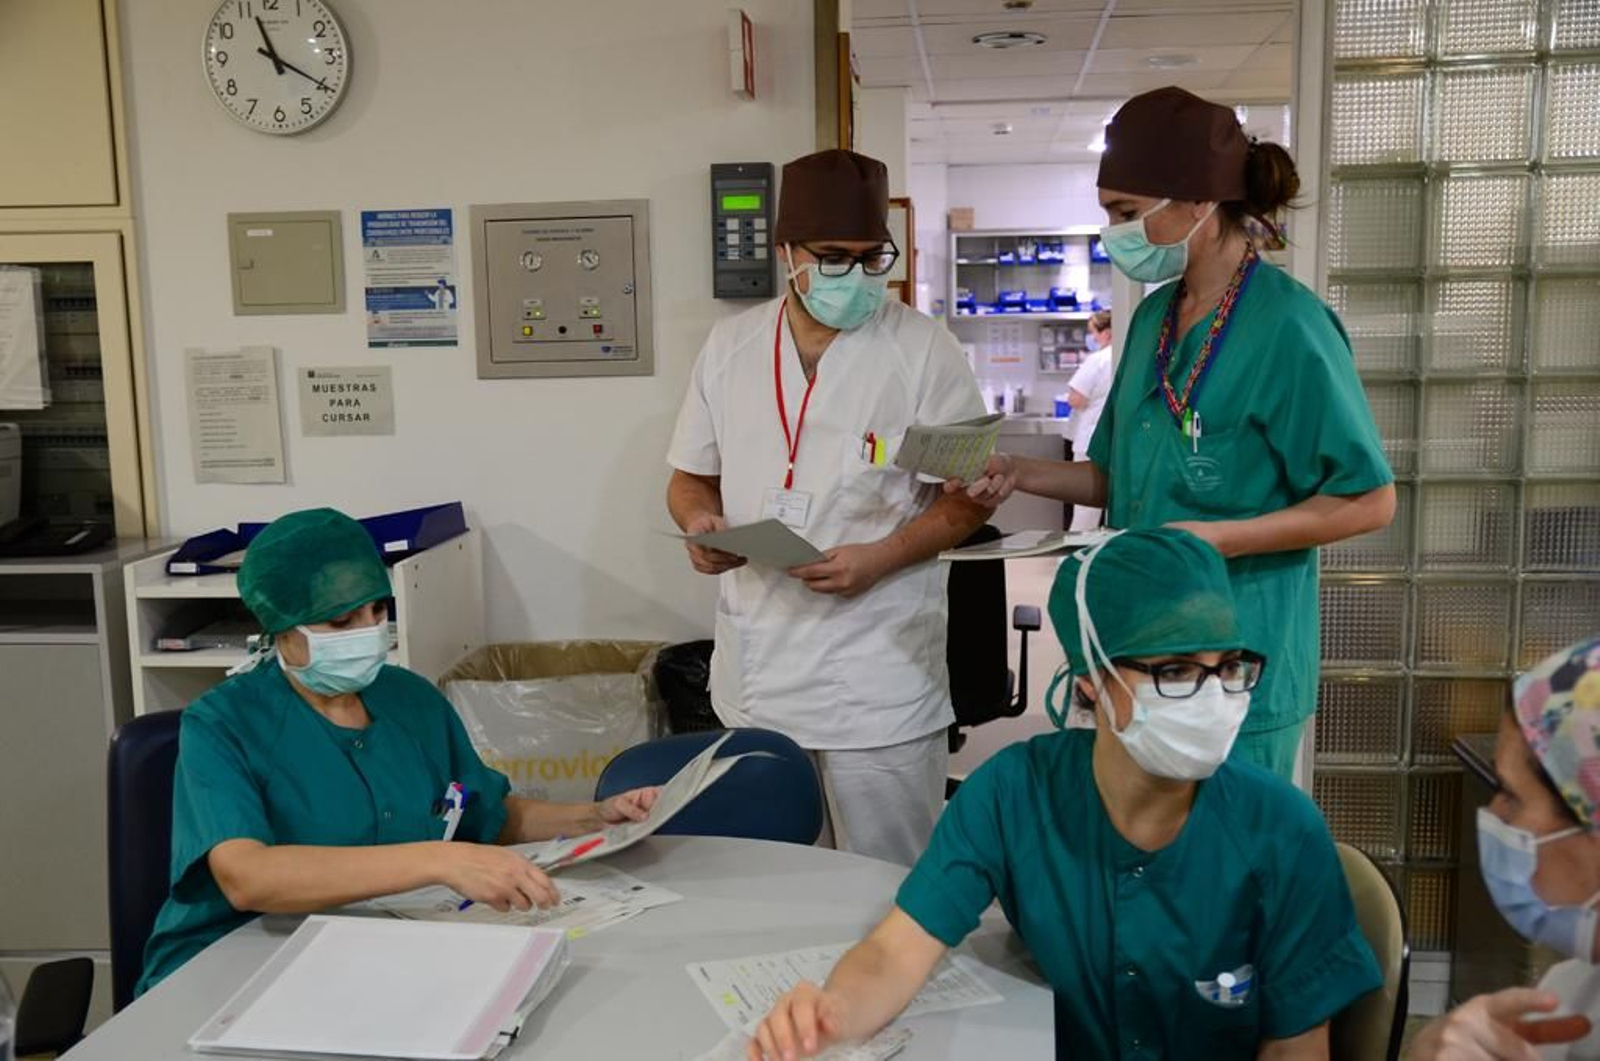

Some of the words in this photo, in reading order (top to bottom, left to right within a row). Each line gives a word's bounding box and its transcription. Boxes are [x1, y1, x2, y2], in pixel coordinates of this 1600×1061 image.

[238, 1, 252, 19] 11
[262, 0, 279, 11] 12
[295, 0, 301, 17] 1
[220, 22, 234, 40] 10
[313, 20, 327, 38] 2
[216, 51, 228, 68] 9
[324, 47, 337, 65] 3
[226, 79, 238, 96] 8
[316, 77, 330, 93] 4
[247, 98, 258, 115] 7
[274, 106, 286, 123] 6
[301, 97, 313, 115] 5
[312, 383, 377, 393] MUESTRAS
[329, 399, 361, 408] PARA
[322, 413, 371, 423] CURSAR
